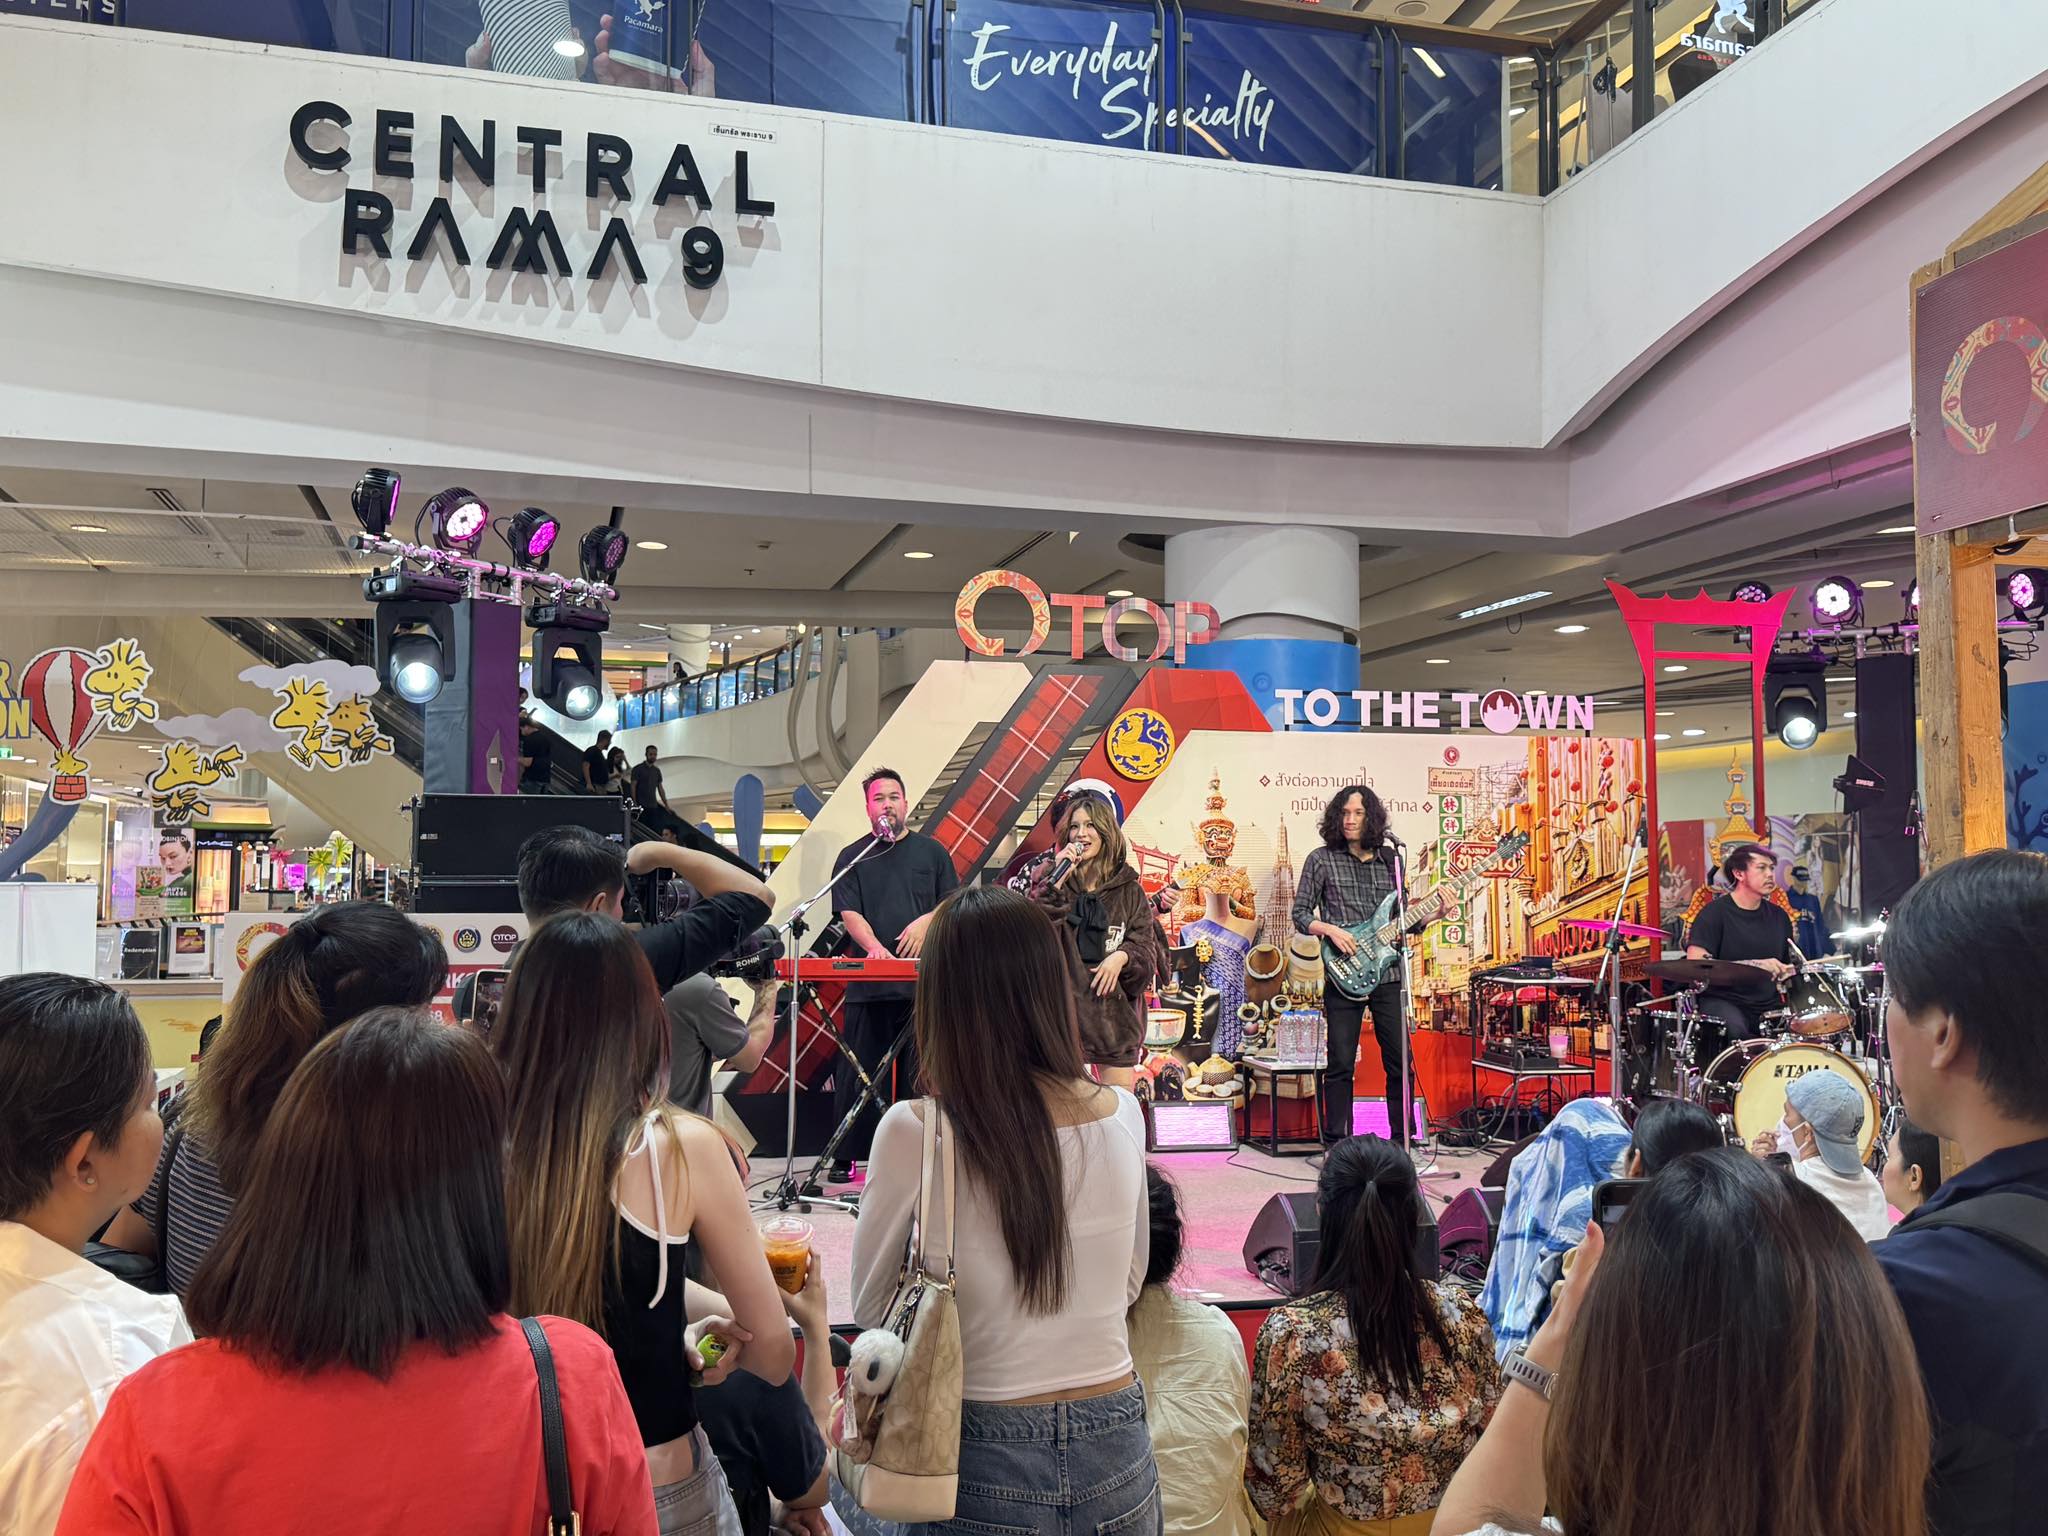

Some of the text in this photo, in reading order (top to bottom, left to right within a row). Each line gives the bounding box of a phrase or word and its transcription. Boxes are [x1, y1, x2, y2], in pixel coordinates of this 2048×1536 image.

[963, 21, 1158, 100] Everyday
[1100, 69, 1274, 152] Specialty
[289, 101, 775, 216] CENTRAL
[343, 189, 724, 290] RAMA 9
[955, 569, 1221, 664] OTOP
[1275, 688, 1595, 735] TO THE TOWN
[1275, 766, 1375, 789] ส่งต่อความภมิใจ
[493, 933, 517, 941] OTOP
[736, 954, 760, 968] RONIN
